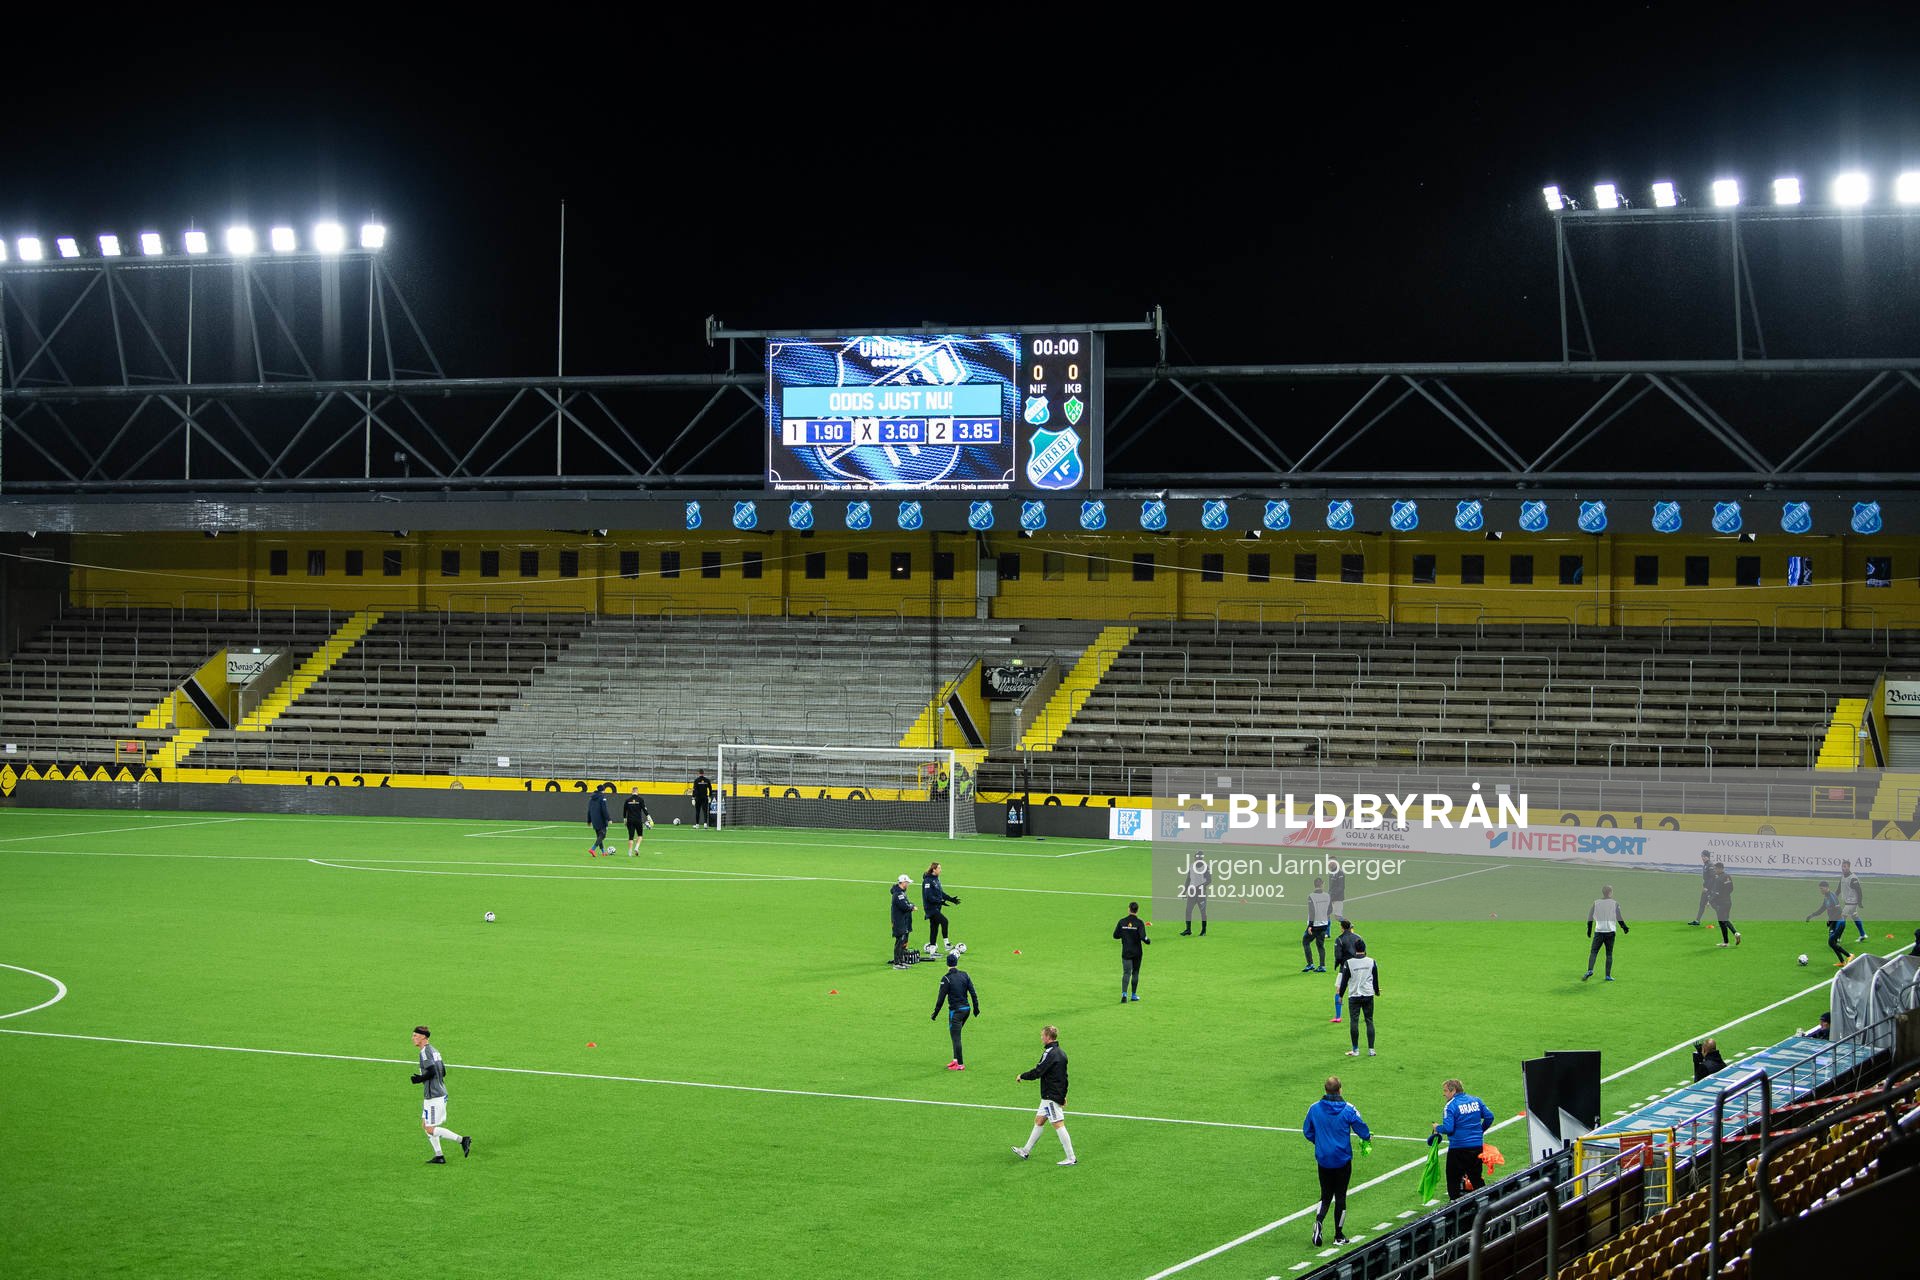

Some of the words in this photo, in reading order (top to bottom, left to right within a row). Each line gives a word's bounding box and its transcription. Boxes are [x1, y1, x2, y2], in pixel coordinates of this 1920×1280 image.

[1033, 339, 1079, 355] 00:00
[1033, 364, 1043, 380] 0
[1068, 364, 1078, 380] 0
[1029, 383, 1047, 394] NIF
[1064, 383, 1082, 394] IKB
[829, 392, 874, 411] ODDS
[878, 392, 922, 410] JUST
[925, 391, 953, 410] NU!
[792, 424, 797, 440] 1
[814, 424, 843, 440] 1.90
[861, 424, 872, 440] X
[885, 424, 919, 440] 3.60
[935, 423, 946, 439] 2
[959, 423, 993, 439] 3.85
[1032, 435, 1073, 475] NORRBY
[1053, 459, 1071, 481] IF
[1346, 831, 1368, 839] GOLV
[1377, 833, 1405, 841] KAKEL
[1511, 831, 1647, 856] INTERSPORT
[1707, 839, 1785, 849] ADVOKATBYRÅN
[1341, 841, 1410, 849] www.mobergsgolv.se
[1767, 854, 1778, 864] &
[1855, 857, 1873, 868] AB
[1458, 1101, 1480, 1115] BRAGE
